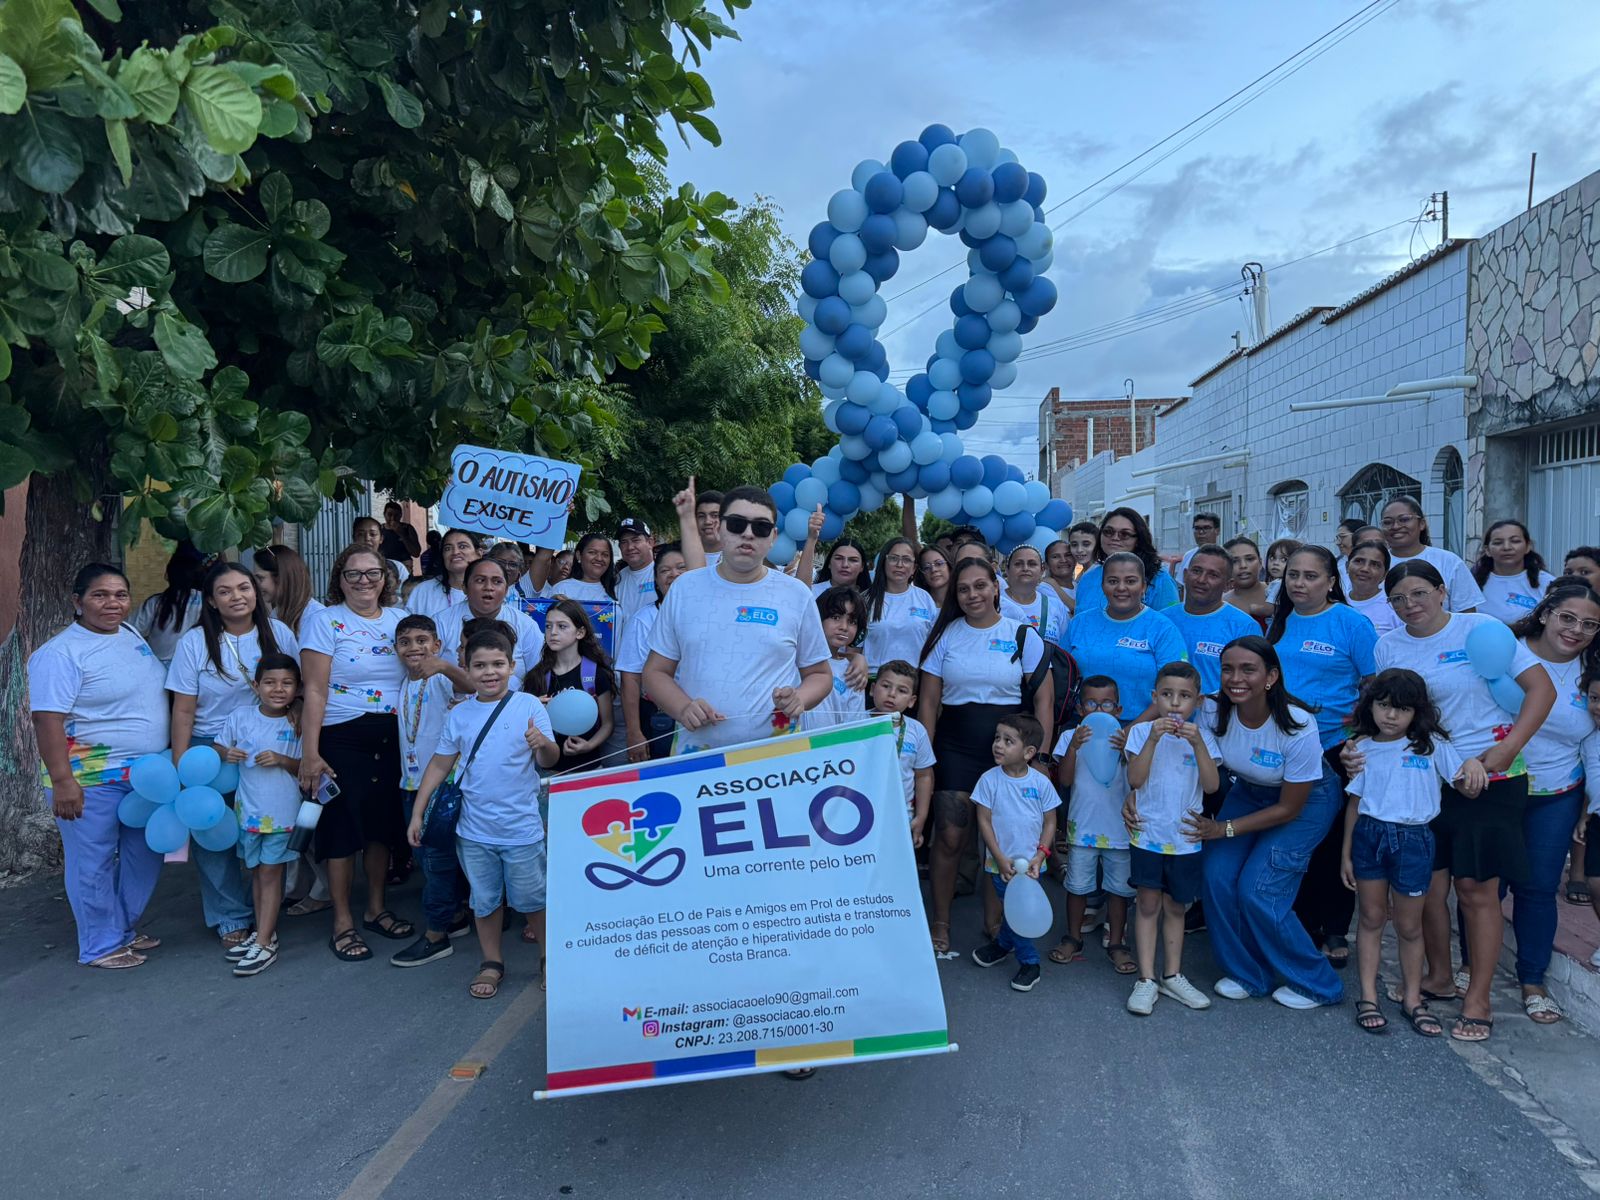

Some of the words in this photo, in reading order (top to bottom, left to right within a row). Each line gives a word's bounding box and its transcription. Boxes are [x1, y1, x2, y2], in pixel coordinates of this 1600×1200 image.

[458, 460, 480, 484] O
[479, 466, 571, 504] AUTISMO
[462, 498, 534, 526] EXISTE
[753, 611, 774, 620] ELO
[1130, 640, 1146, 648] ELO
[696, 759, 856, 798] ASSOCIAÇÃO
[698, 785, 874, 856] ELO
[704, 865, 740, 878] Uma
[745, 858, 805, 874] corrente
[810, 856, 840, 872] pelo
[844, 853, 876, 867] bem
[585, 916, 654, 932] Associação
[658, 911, 684, 924] ELO
[688, 909, 702, 920] de
[706, 907, 731, 918] Pais
[745, 902, 787, 915] Amigos
[790, 902, 807, 912] em
[811, 898, 832, 910] Prol
[836, 897, 849, 907] de
[853, 894, 894, 905] estudos
[565, 941, 573, 949] e
[577, 933, 632, 947] cuidados
[636, 930, 657, 941] das
[662, 925, 710, 942] pessoas
[714, 922, 738, 932] com
[742, 922, 749, 930] o
[753, 916, 800, 930] espectro
[805, 911, 841, 925] autista
[855, 908, 911, 919] transtornos
[615, 947, 630, 958] de
[634, 943, 669, 956] déficit
[673, 941, 688, 951] de
[692, 936, 738, 950] atenção
[742, 937, 749, 945] e
[753, 927, 831, 945] hiperatividade
[835, 926, 848, 936] do
[852, 924, 874, 937] polo
[709, 952, 743, 964] Costa
[747, 947, 791, 960] Branca.
[645, 1003, 688, 1018] E-mail:
[693, 987, 859, 1013] associacaoelo90@gmail.com
[661, 1017, 729, 1034] Instagram:
[733, 1004, 845, 1028] @associacao.elo.rn
[675, 1034, 714, 1049] CNPJ:
[718, 1021, 834, 1044] 23.208.715/0001-30
